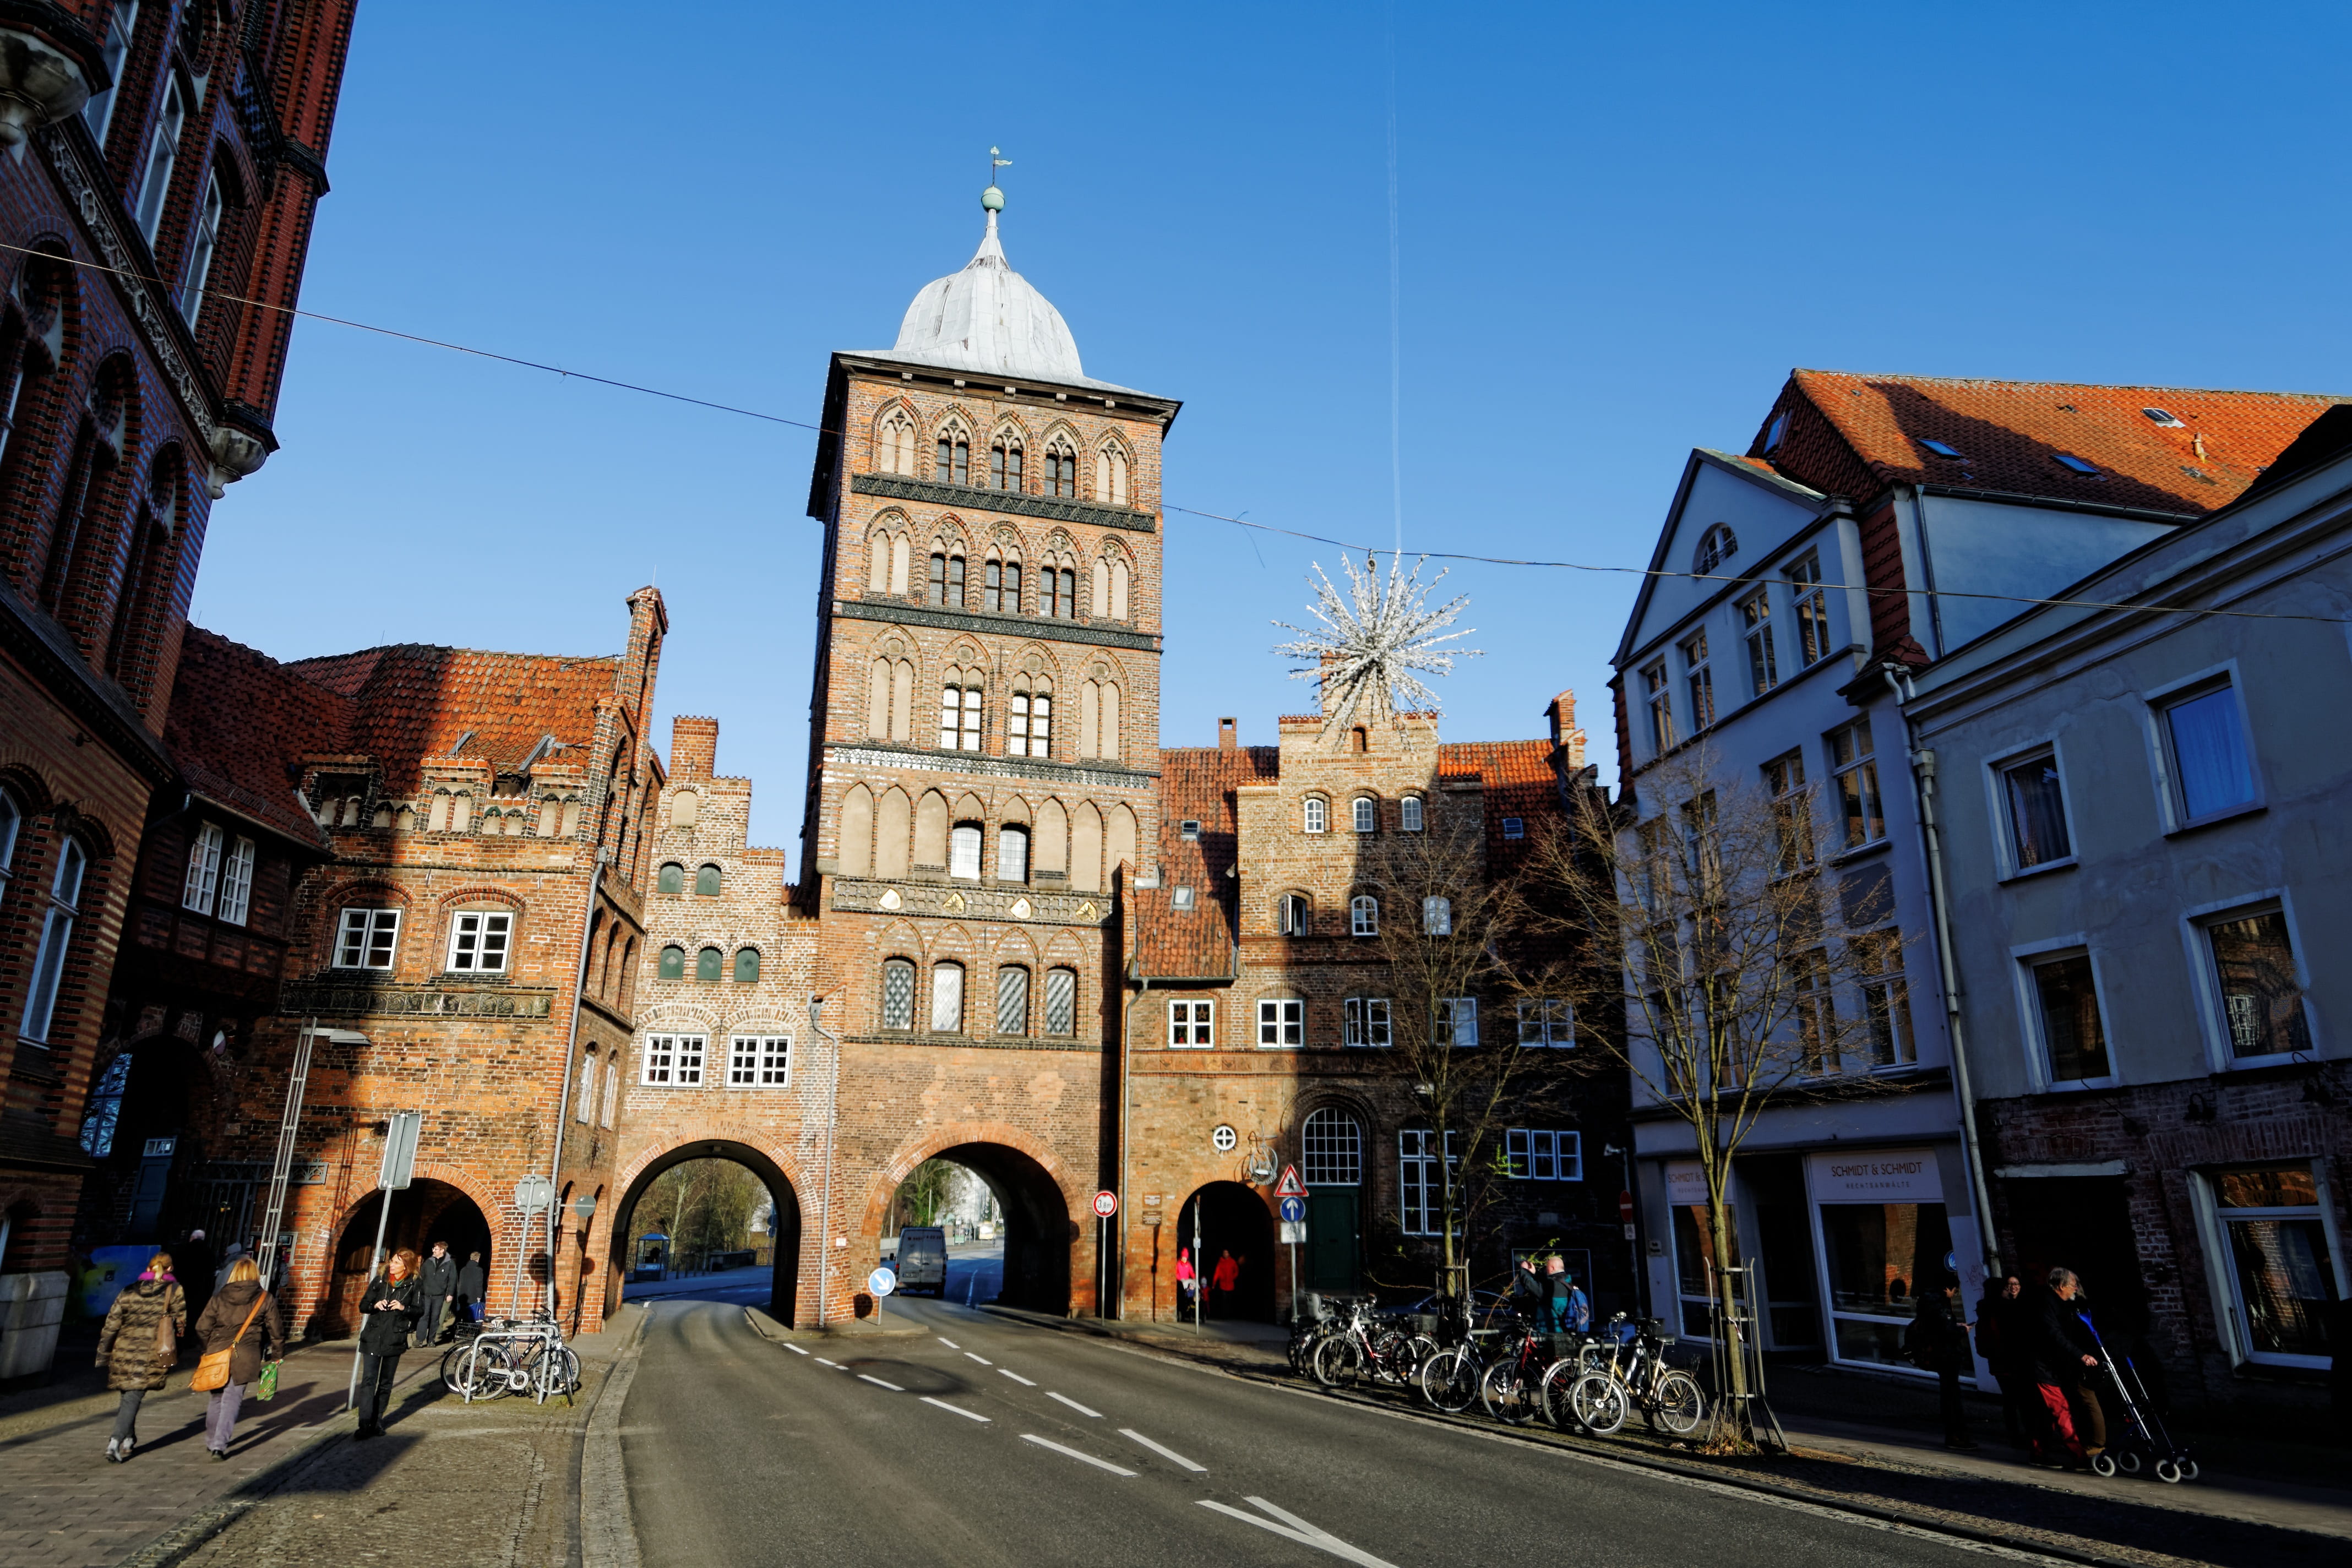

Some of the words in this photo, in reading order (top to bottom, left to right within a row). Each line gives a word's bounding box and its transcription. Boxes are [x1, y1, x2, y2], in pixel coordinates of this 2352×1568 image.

[1832, 1164, 1868, 1177] SCHMIDT
[1871, 1164, 1879, 1175] &
[1881, 1162, 1922, 1175] SCHMIDT
[1668, 1172, 1694, 1183] SCHMIDT
[1845, 1180, 1910, 1189] RECHTSANWÄLTE
